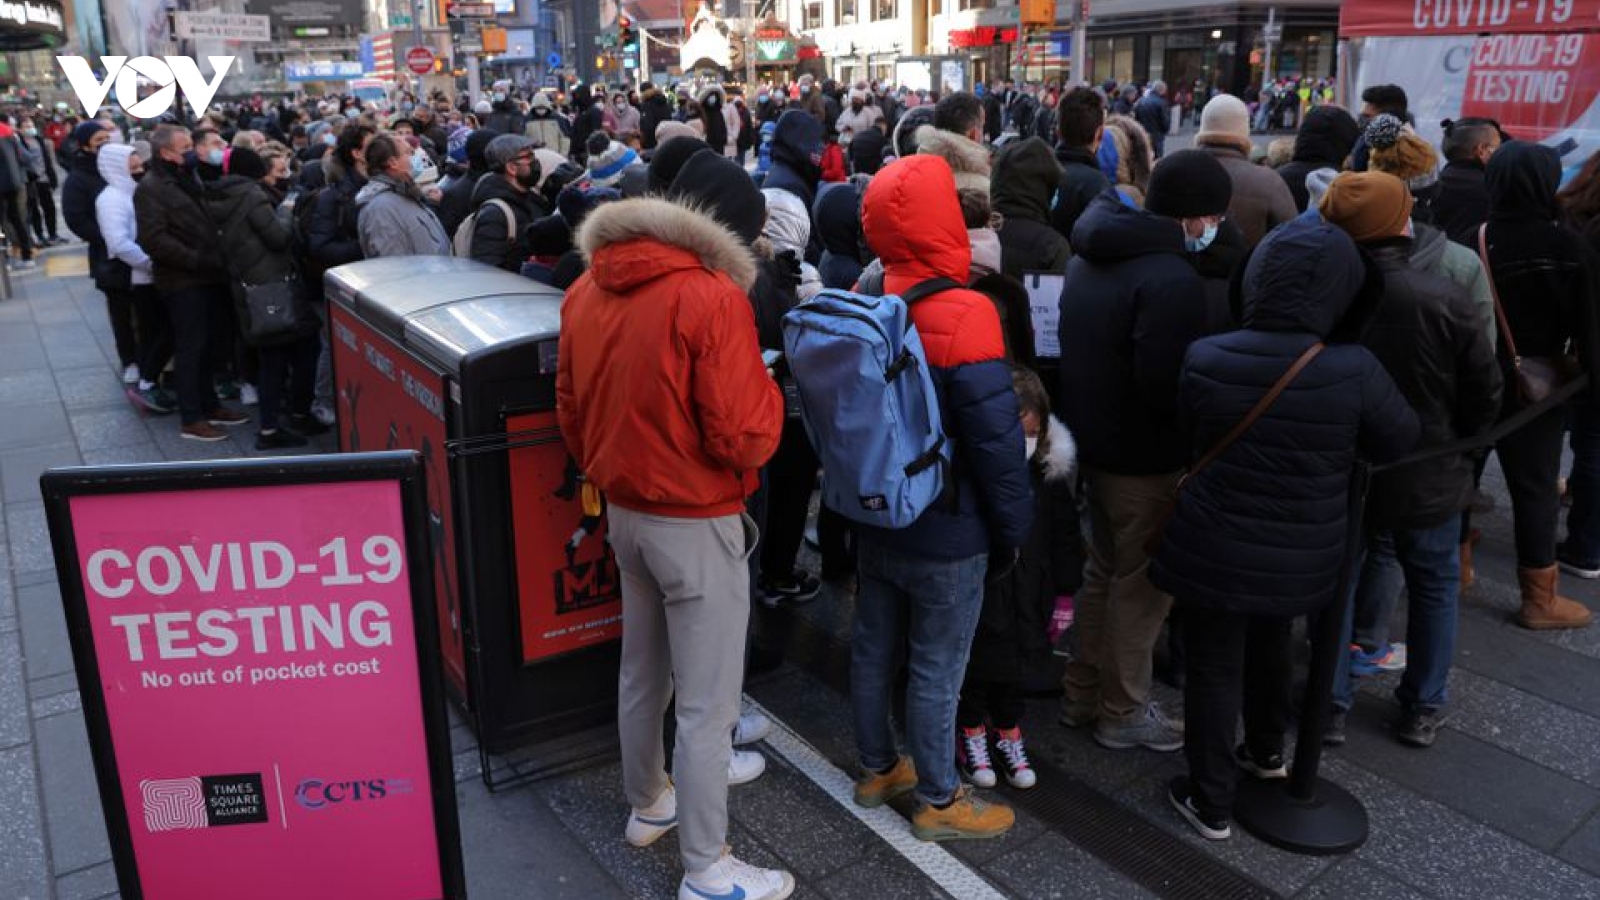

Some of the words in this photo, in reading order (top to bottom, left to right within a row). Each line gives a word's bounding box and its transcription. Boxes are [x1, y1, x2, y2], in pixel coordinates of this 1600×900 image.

[1413, 0, 1574, 29] COVID-19
[1473, 34, 1584, 67] COVID-19
[1472, 70, 1569, 104] TESTING
[87, 535, 402, 598] COVID-19
[110, 600, 392, 662] TESTING
[141, 670, 172, 688] No
[179, 668, 215, 686] out
[221, 664, 244, 683] of
[250, 660, 327, 684] pocket
[332, 657, 380, 676] cost
[210, 794, 259, 807] SQUARE
[213, 782, 254, 795] TIMES
[215, 805, 258, 817] ALLIANCE
